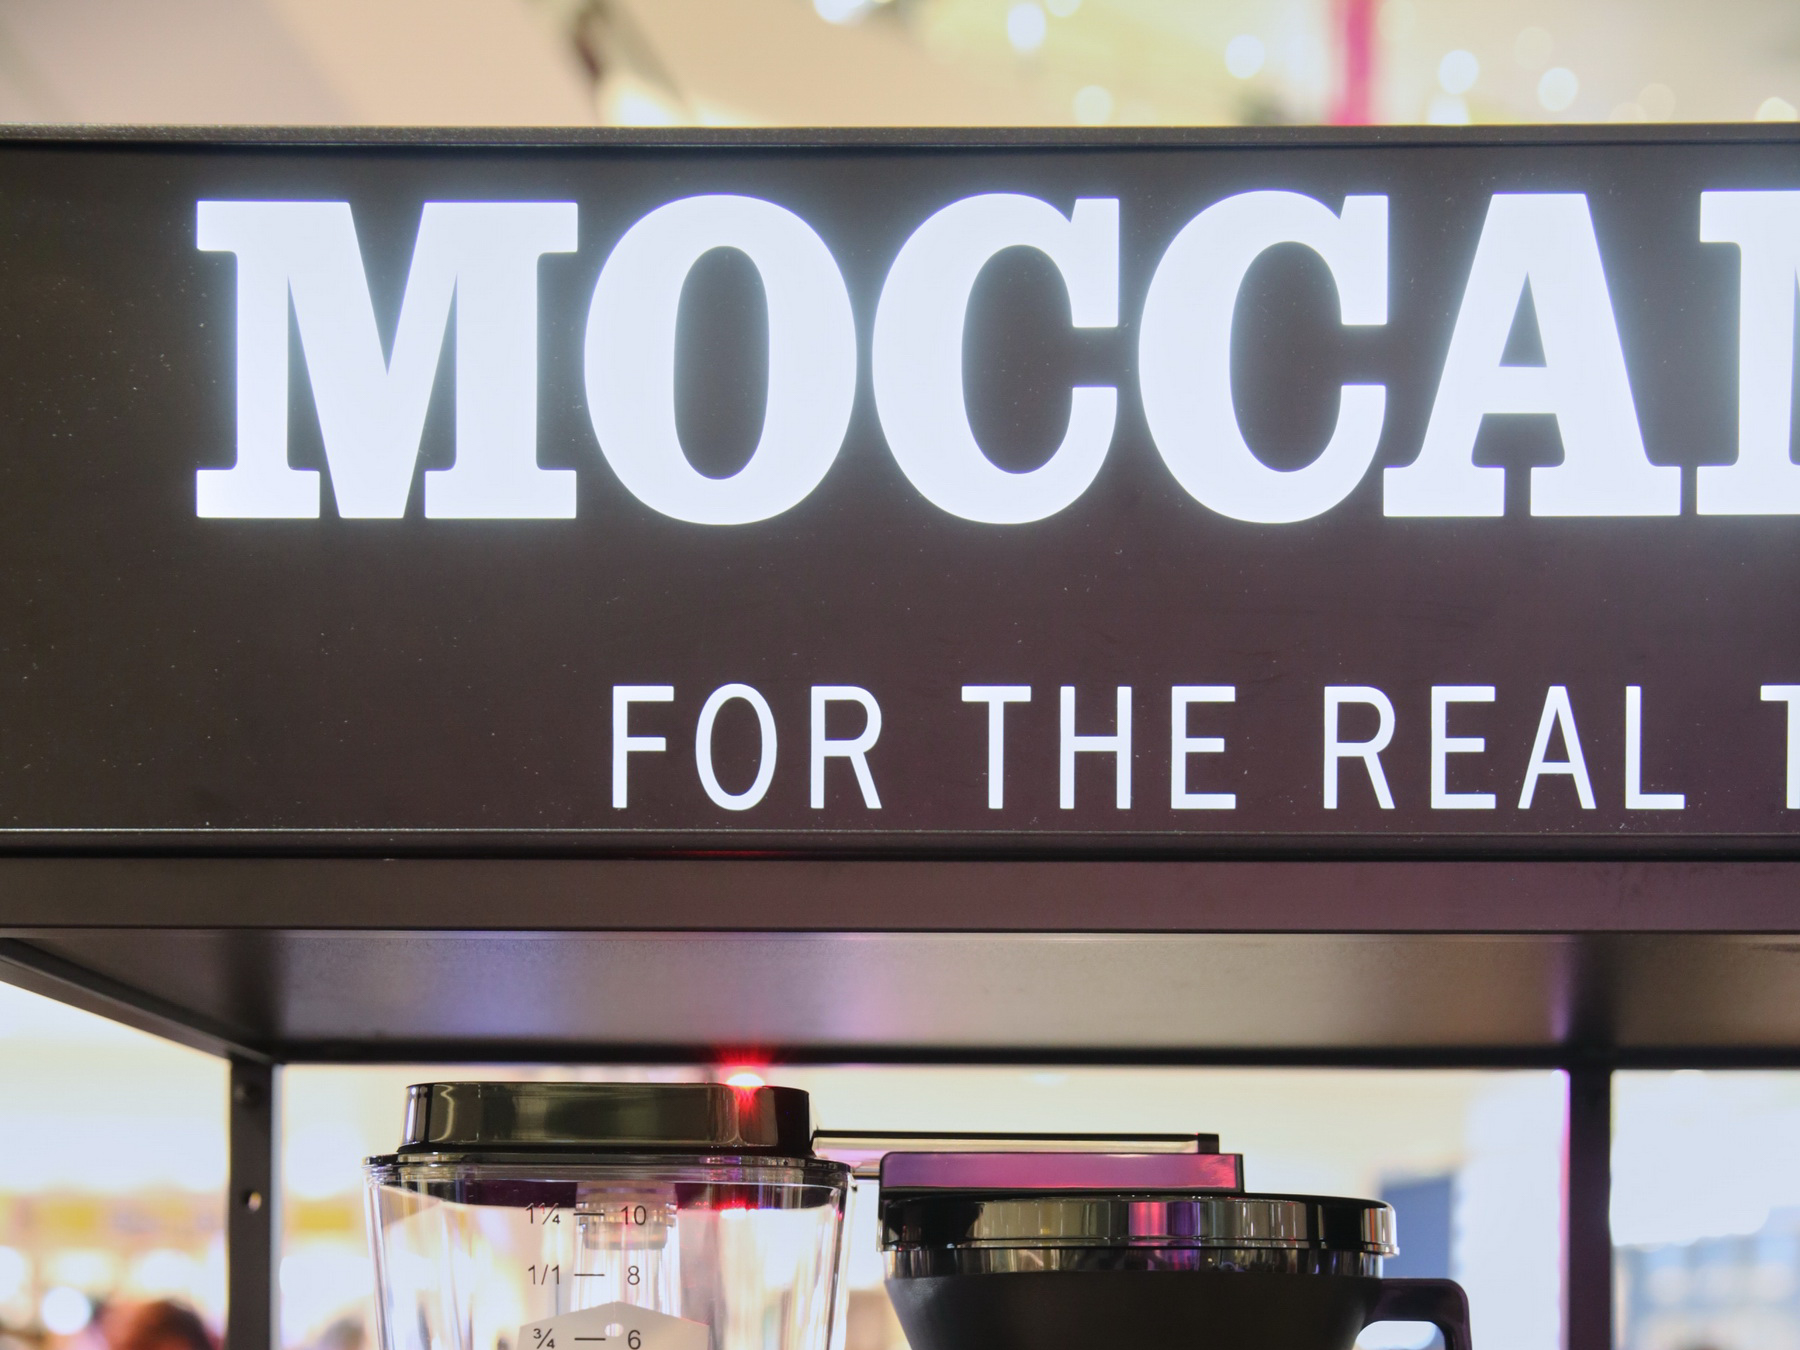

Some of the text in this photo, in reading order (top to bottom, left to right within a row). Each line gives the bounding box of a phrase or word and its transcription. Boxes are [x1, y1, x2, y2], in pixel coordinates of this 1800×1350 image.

[196, 190, 1800, 526] MOCCA
[611, 683, 883, 812] FOR
[961, 685, 1236, 810] THE
[1323, 685, 1685, 810] REAL
[620, 1204, 647, 1226] 10
[527, 1264, 641, 1286] 1/1 8
[627, 1329, 642, 1350] 6
